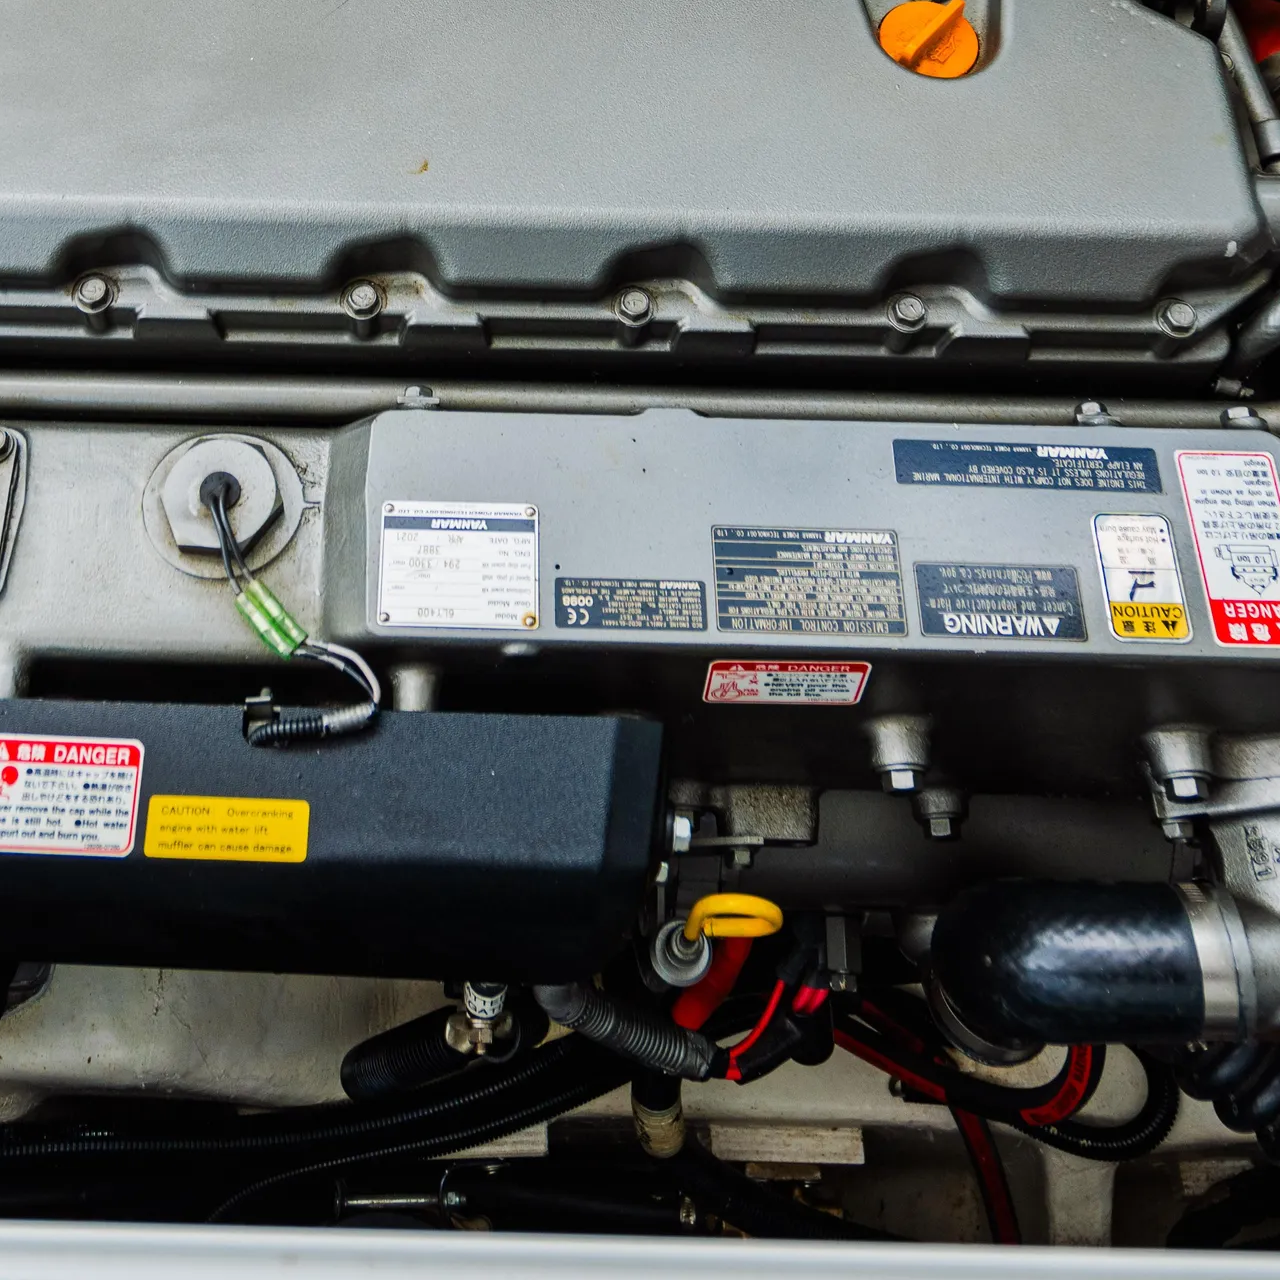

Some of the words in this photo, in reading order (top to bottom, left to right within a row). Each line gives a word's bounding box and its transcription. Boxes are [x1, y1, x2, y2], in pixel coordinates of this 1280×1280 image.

[1036, 446, 1109, 460] YANMAR
[968, 465, 978, 474] BY
[981, 465, 1013, 475] COVERED
[1016, 466, 1034, 475] ALSO
[1037, 467, 1047, 475] IS
[1133, 462, 1143, 470] AN
[912, 472, 940, 482] MARINE
[1051, 468, 1061, 476] IT
[1064, 468, 1092, 477] UNLESS
[1095, 469, 1145, 478] REGULATIONS
[943, 473, 1000, 483] INTERNATIONAL
[1004, 475, 1024, 484] WITH
[1026, 475, 1053, 485] COMPLY
[1058, 477, 1072, 486] NOT
[1074, 478, 1094, 487] DOES
[1097, 479, 1124, 488] ENGINE
[1128, 480, 1146, 489] THIS
[1248, 489, 1262, 497] only
[1234, 499, 1254, 507] lifting
[431, 518, 488, 530] YANMAR
[396, 532, 418, 542] 2021
[747, 530, 779, 538] TECHNOLOGY
[824, 531, 893, 544] YANMAR
[409, 558, 433, 569] 3300
[1237, 555, 1250, 564] ton
[1254, 555, 1266, 564] 1.0
[660, 581, 700, 590] YANMAR
[562, 595, 593, 607] 0098
[956, 598, 1017, 612] Reproductive
[1022, 600, 1036, 613] and
[1043, 601, 1074, 615] Cancer
[1113, 605, 1183, 619] CAUTION
[731, 618, 793, 631] INFORMATION
[800, 619, 839, 631] CONTROL
[843, 620, 889, 633] EMISSION
[943, 614, 1045, 636] WARNING
[1227, 622, 1271, 642] 危険
[17, 743, 46, 761] 危険
[54, 744, 130, 765] DANGER
[52, 805, 66, 814] the
[69, 808, 84, 817] cap
[89, 807, 112, 816] while
[115, 807, 129, 816] the
[162, 805, 210, 816] CAUTION
[227, 808, 294, 820] Overcranking
[25, 817, 41, 825] still
[81, 819, 98, 828] Hot
[103, 820, 127, 829] water
[159, 823, 192, 833] engine
[196, 824, 217, 833] with
[221, 826, 250, 834] water
[21, 829, 36, 838] out
[38, 830, 55, 839] and
[57, 831, 78, 840] burn
[158, 840, 194, 850] muffler
[198, 843, 216, 851] can
[220, 843, 249, 852] cause
